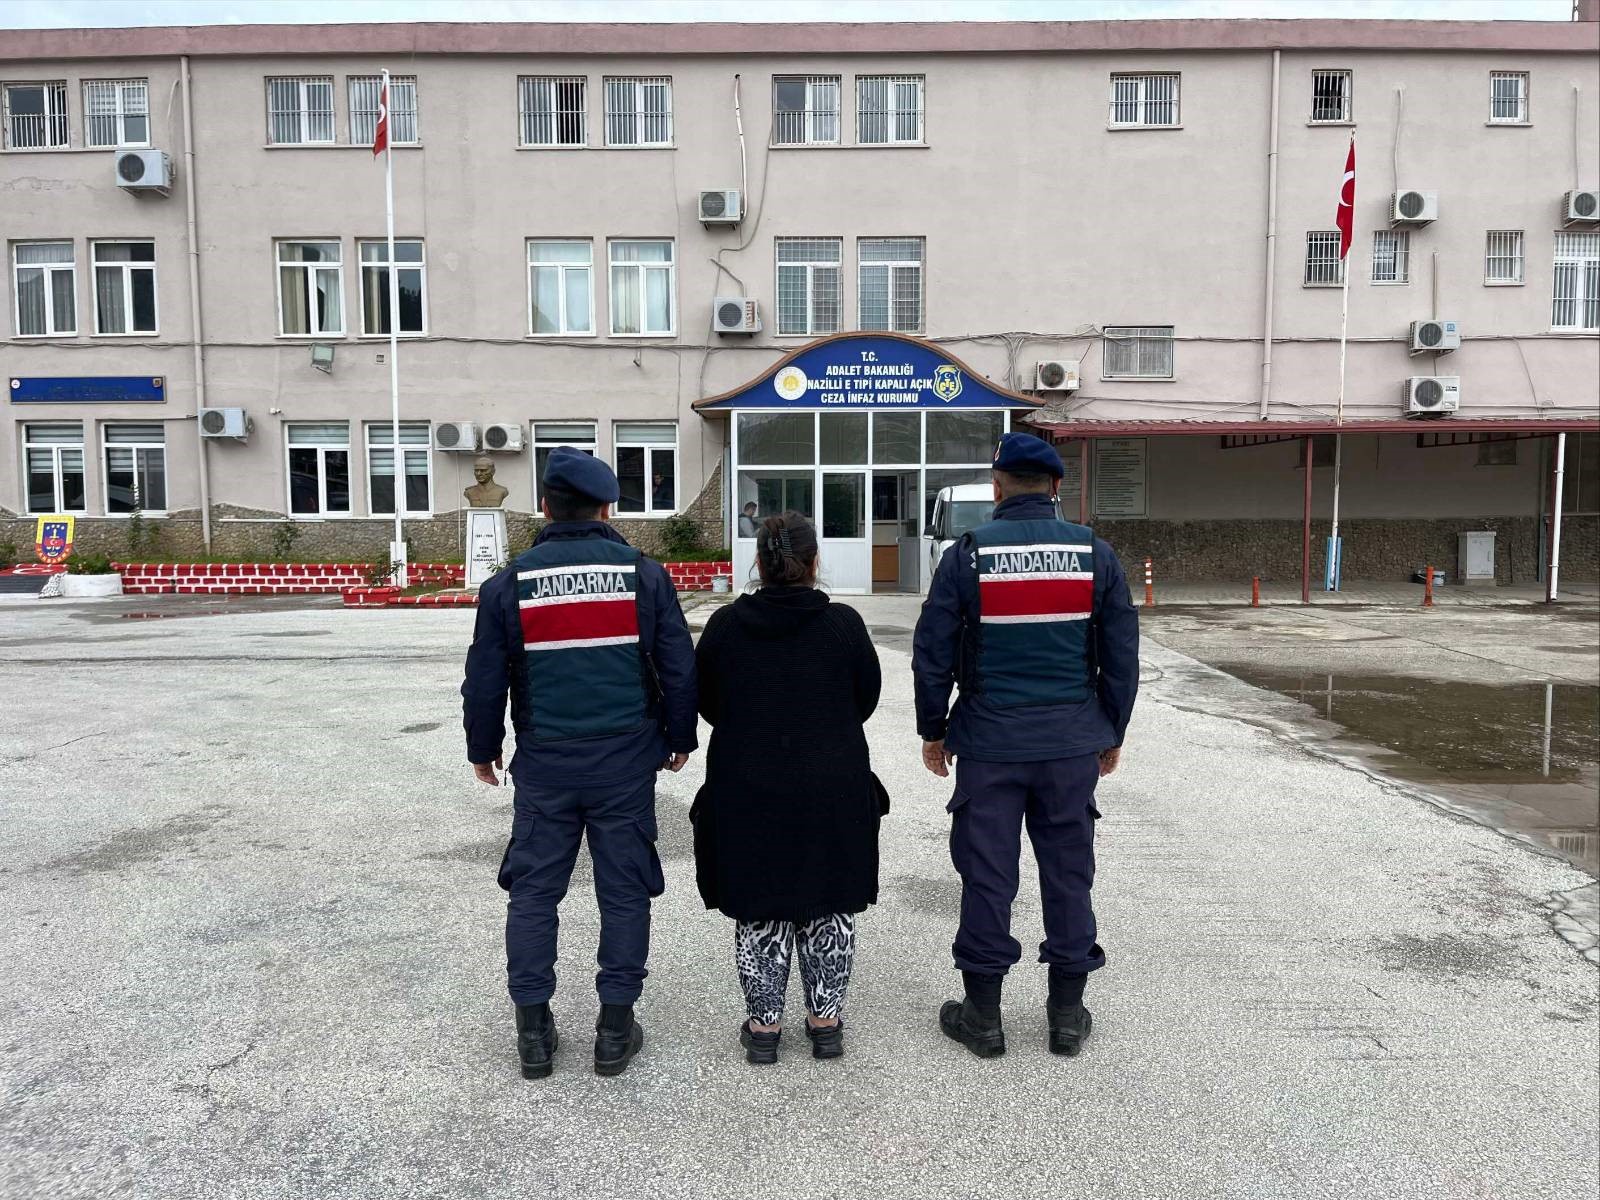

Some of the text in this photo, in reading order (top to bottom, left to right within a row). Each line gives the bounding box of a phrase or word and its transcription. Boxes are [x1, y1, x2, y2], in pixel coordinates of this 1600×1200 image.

[861, 351, 878, 362] T.C.
[826, 363, 913, 376] ADALET BAKANLIĞI
[807, 379, 842, 390] NAZİLLİ
[845, 379, 851, 390] E
[875, 379, 907, 390] KAPALI
[910, 379, 933, 392] AÇIK
[821, 391, 918, 403] CEZA İNFAZ KURUMU
[990, 551, 1081, 574] JANDARMA
[532, 573, 628, 599] JANDARMA
